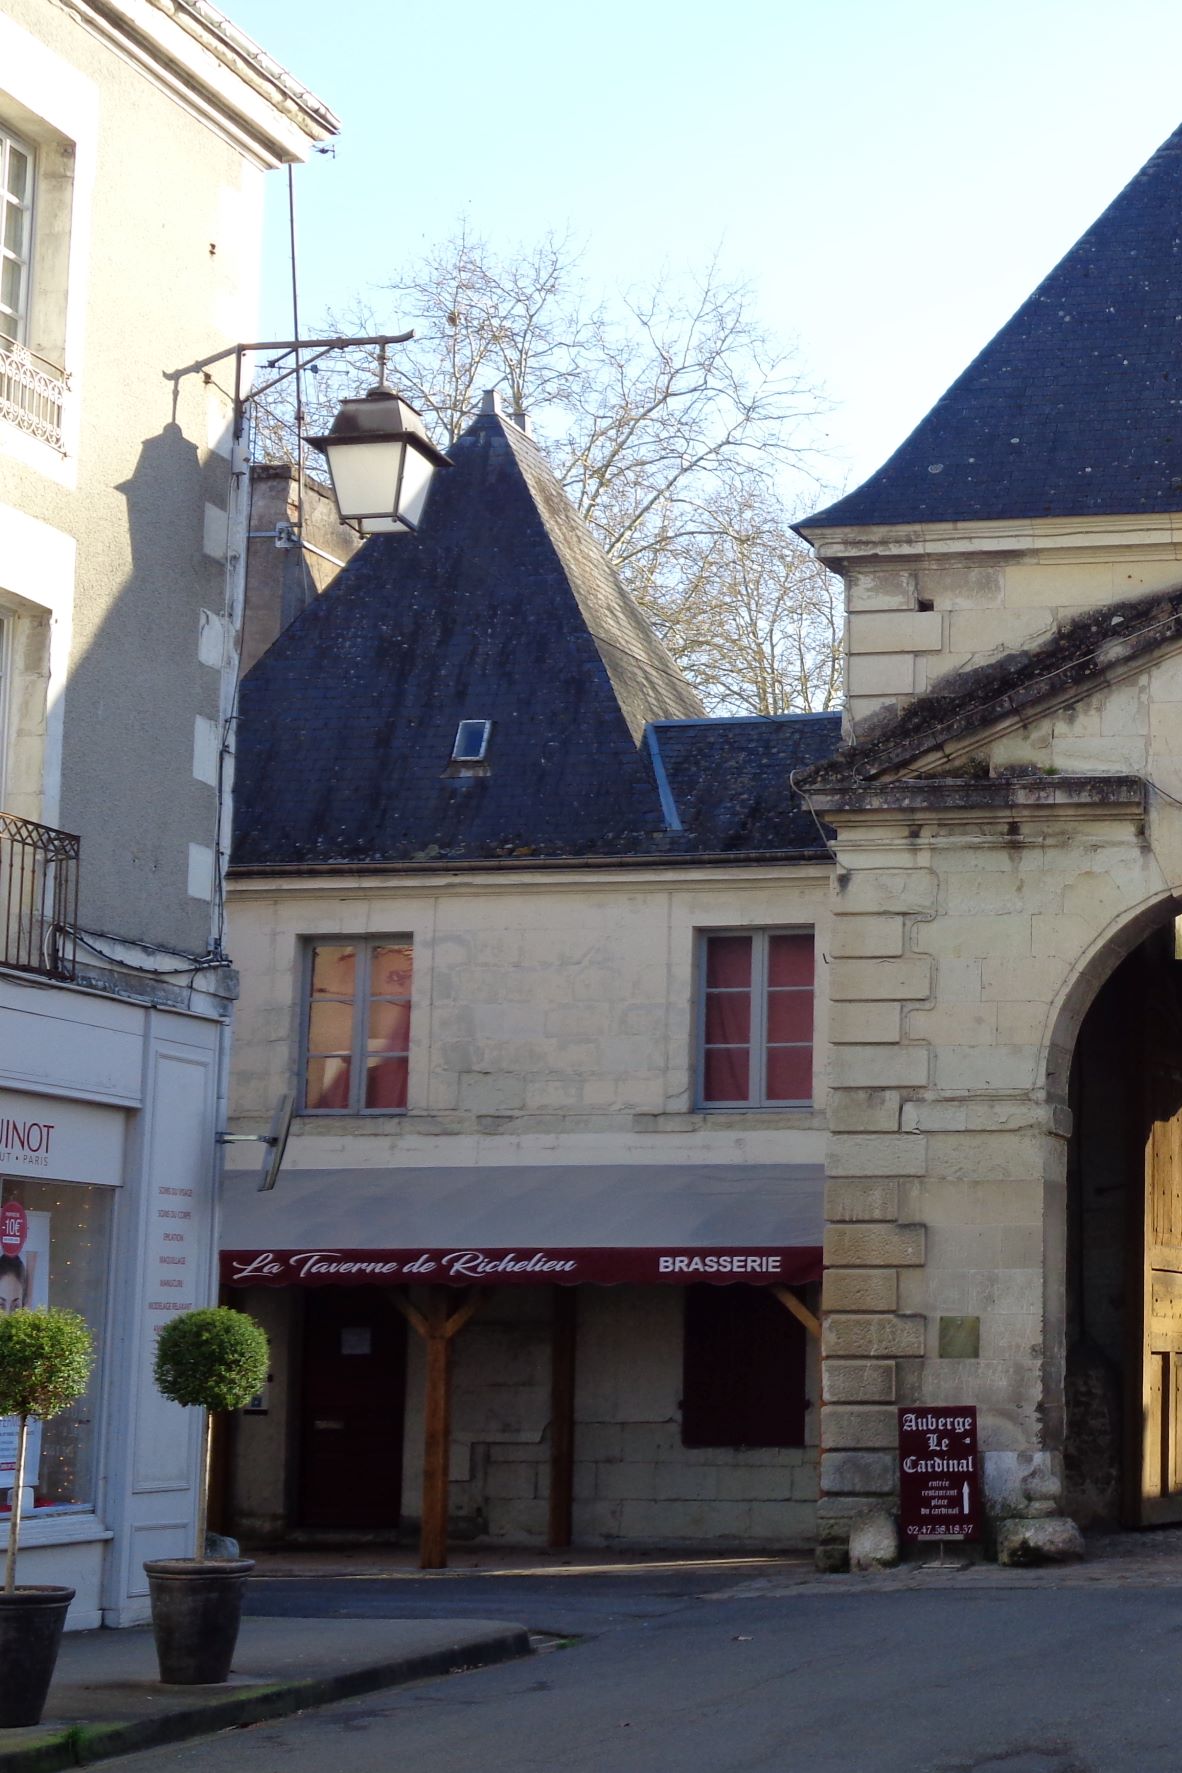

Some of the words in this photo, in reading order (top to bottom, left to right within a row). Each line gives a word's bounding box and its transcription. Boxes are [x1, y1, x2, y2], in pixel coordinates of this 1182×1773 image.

[23, 1154, 49, 1167] PARIS
[232, 1252, 284, 1280] La
[289, 1252, 399, 1277] Taverne
[402, 1254, 437, 1273] de
[441, 1251, 577, 1277] Richelieu
[659, 1256, 782, 1272] BRASSERIE
[902, 1413, 973, 1433] Auberge
[926, 1433, 950, 1451] Le
[903, 1455, 975, 1473] Cardinal
